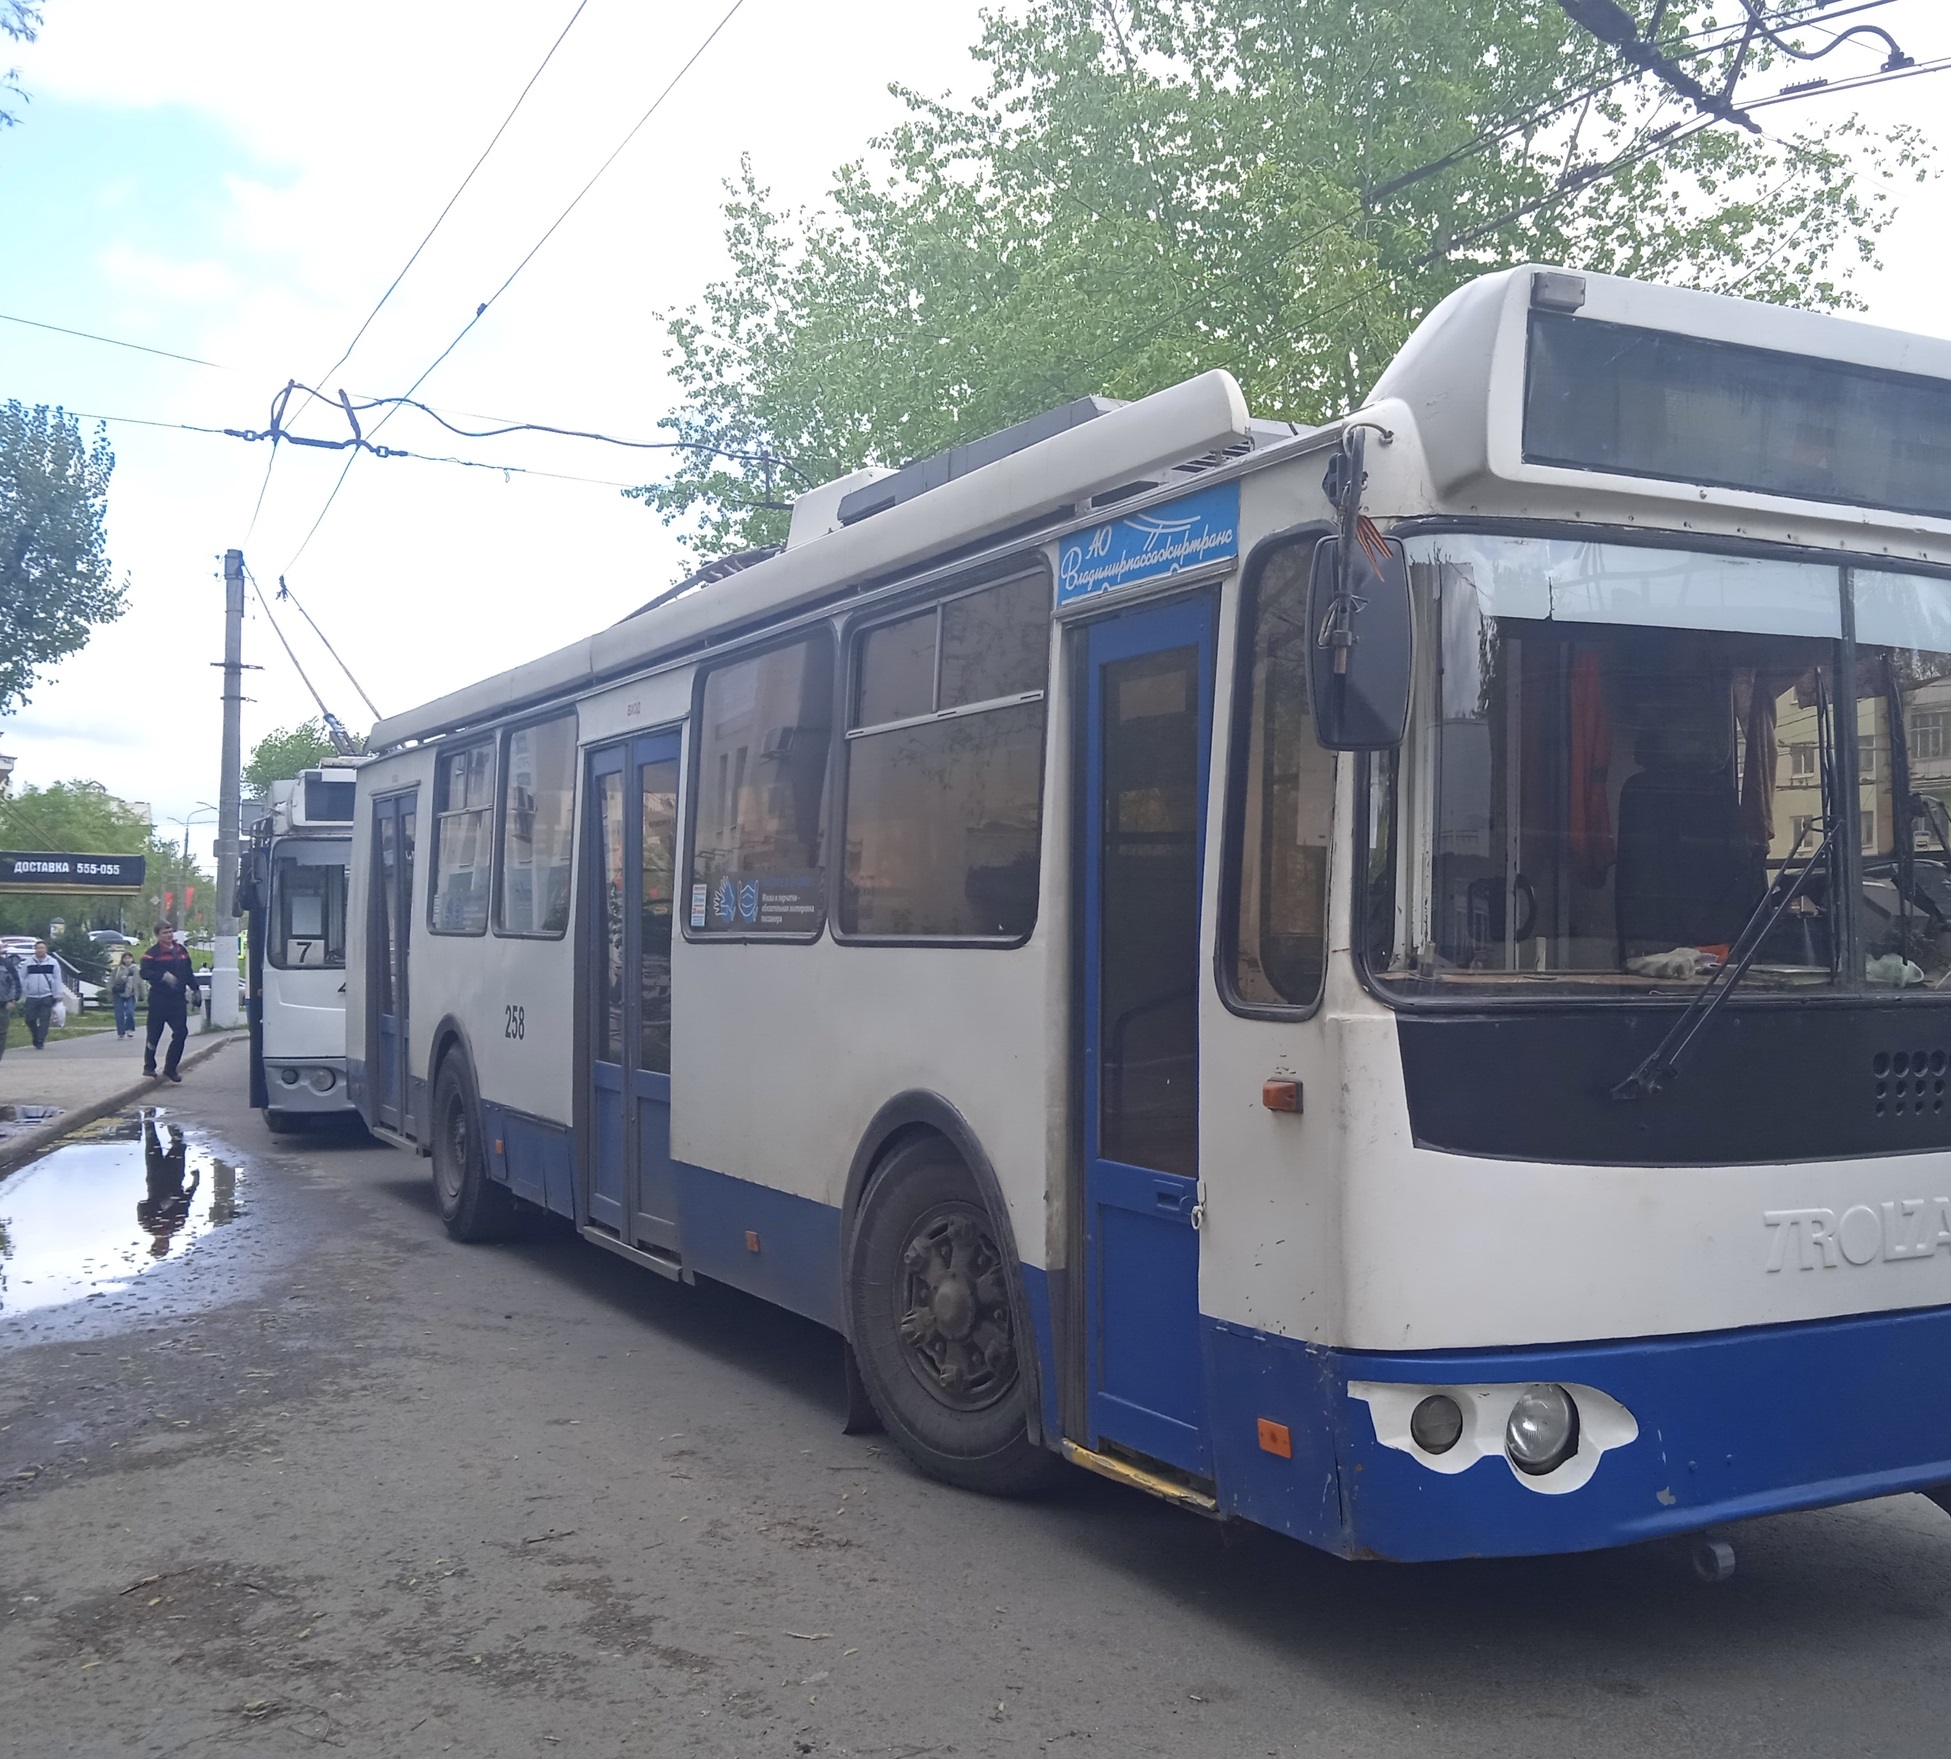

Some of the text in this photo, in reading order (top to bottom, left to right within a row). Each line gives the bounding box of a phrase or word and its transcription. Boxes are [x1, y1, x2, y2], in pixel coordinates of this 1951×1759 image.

[1061, 524, 1233, 591] Владимирпассажиртранс
[1085, 525, 1112, 560] АО
[14, 861, 120, 875] ДОСТАВКА 555-055
[296, 942, 312, 963] 7
[505, 1005, 525, 1040] 258
[1763, 1197, 1951, 1274] TROLZA
